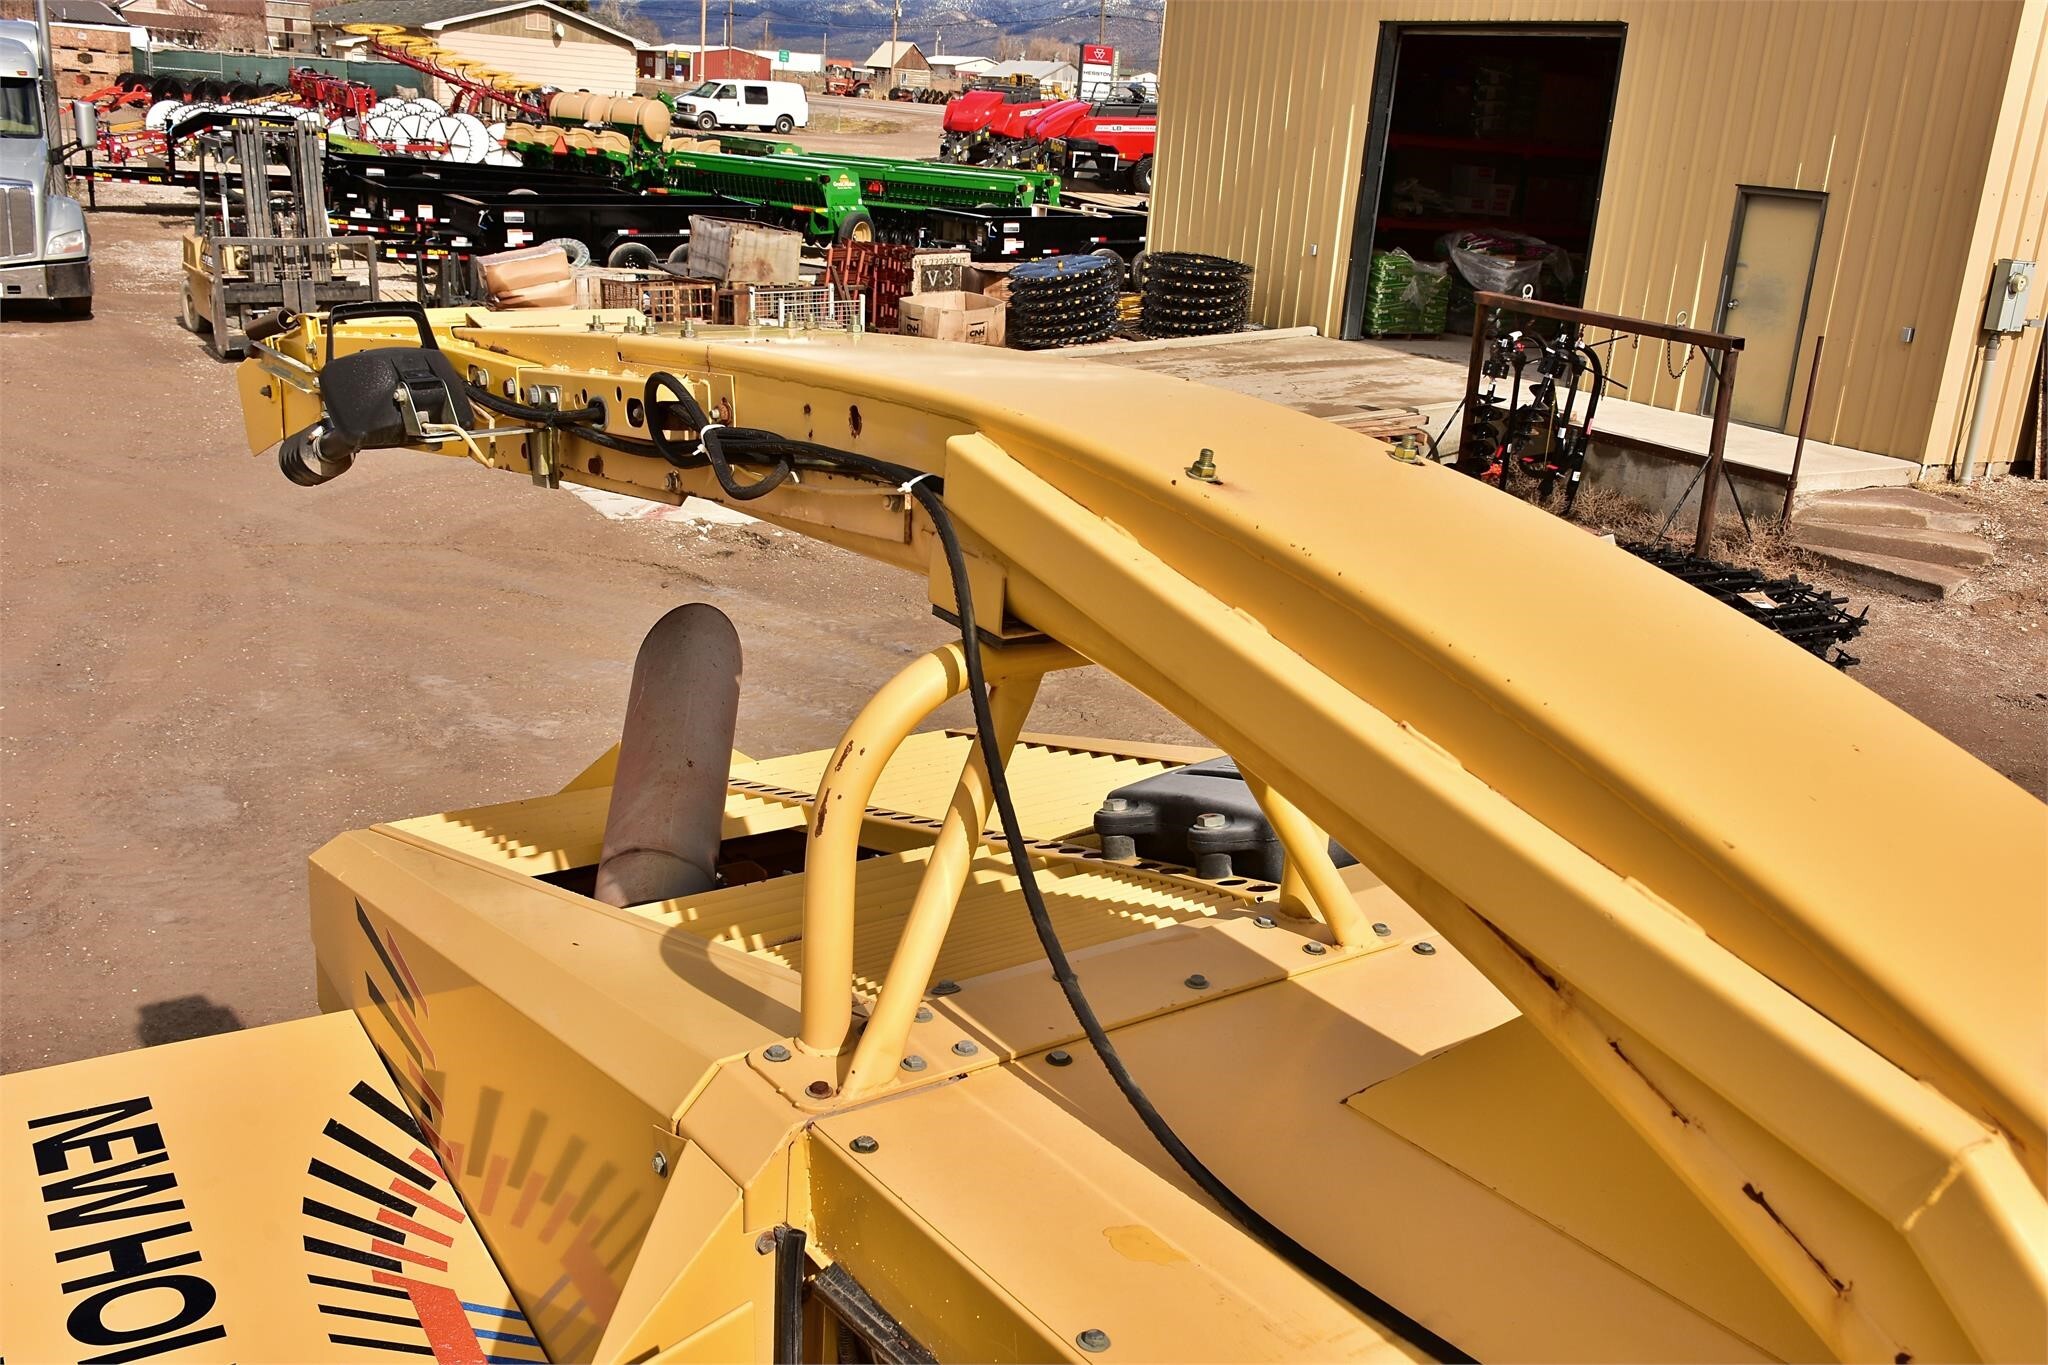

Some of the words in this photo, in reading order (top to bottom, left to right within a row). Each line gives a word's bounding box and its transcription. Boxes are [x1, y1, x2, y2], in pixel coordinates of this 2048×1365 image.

[926, 270, 939, 287] V
[944, 270, 953, 286] 3
[906, 323, 919, 334] CNH
[969, 326, 985, 337] CNH
